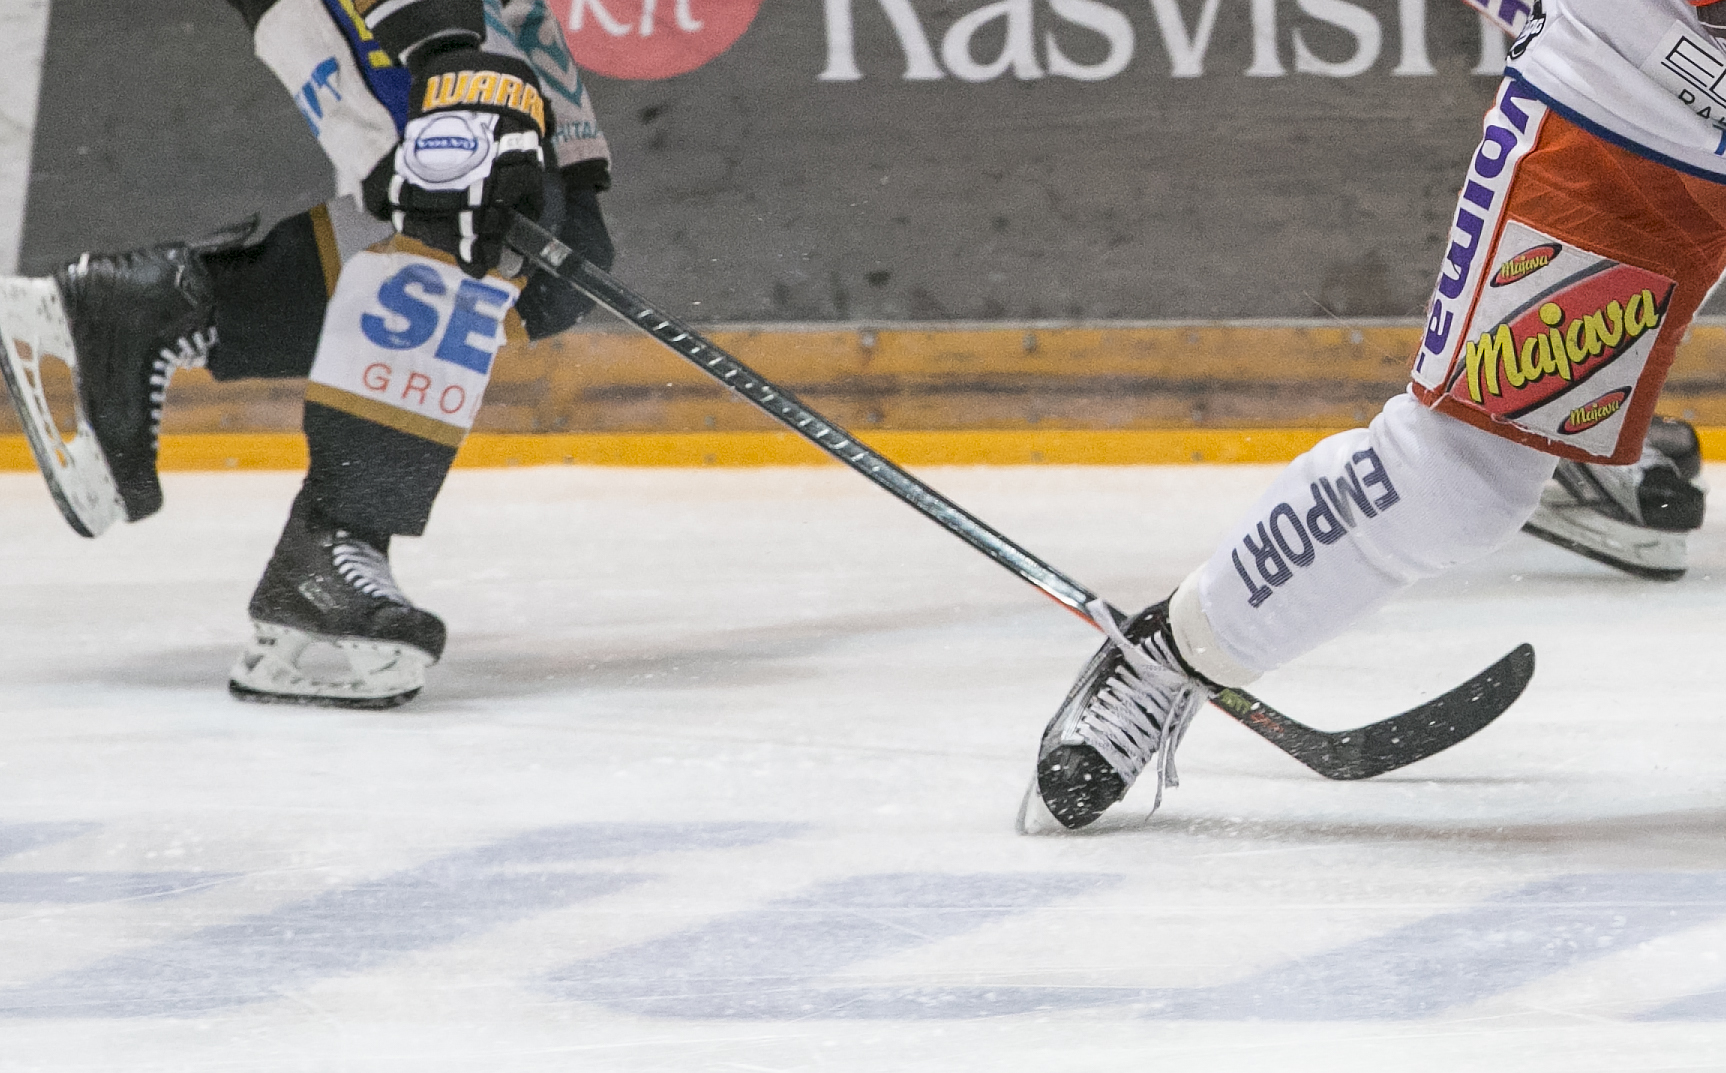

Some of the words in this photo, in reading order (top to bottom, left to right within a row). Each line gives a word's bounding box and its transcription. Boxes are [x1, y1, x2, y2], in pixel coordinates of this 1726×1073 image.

[1501, 252, 1549, 280] Majava
[360, 263, 513, 376] SE
[1465, 286, 1660, 404] Majava
[1569, 397, 1622, 431] Majava
